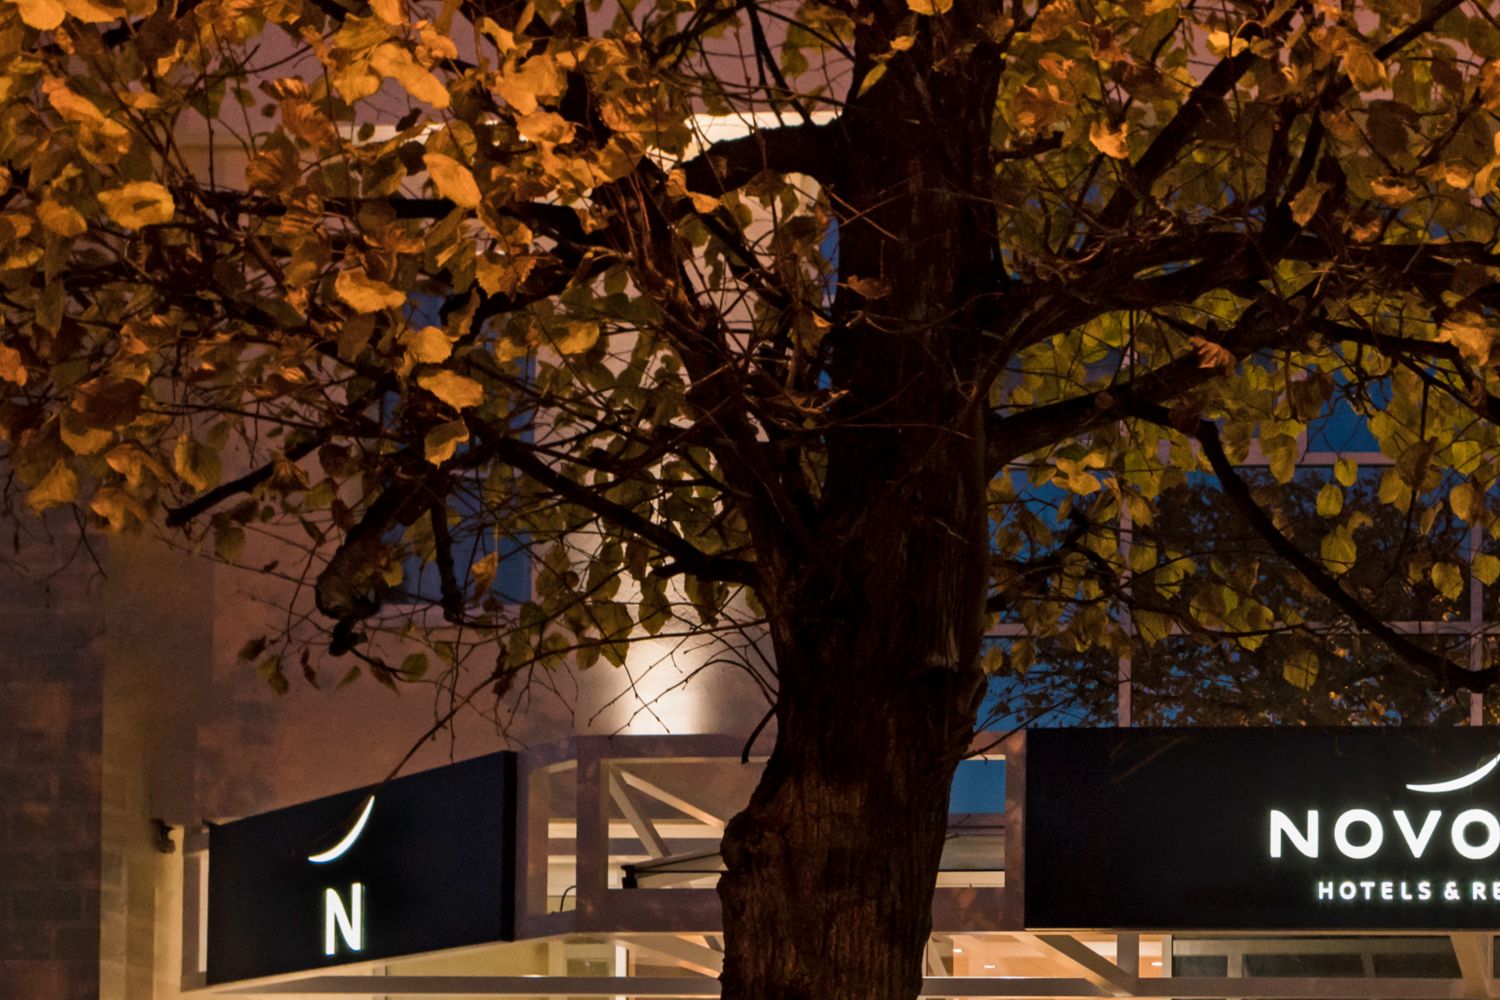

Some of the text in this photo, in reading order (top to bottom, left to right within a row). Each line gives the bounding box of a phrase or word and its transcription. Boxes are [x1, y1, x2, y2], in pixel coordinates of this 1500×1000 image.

[1317, 880, 1433, 901] HOTELS
[1443, 880, 1461, 901] &
[325, 882, 363, 956] N
